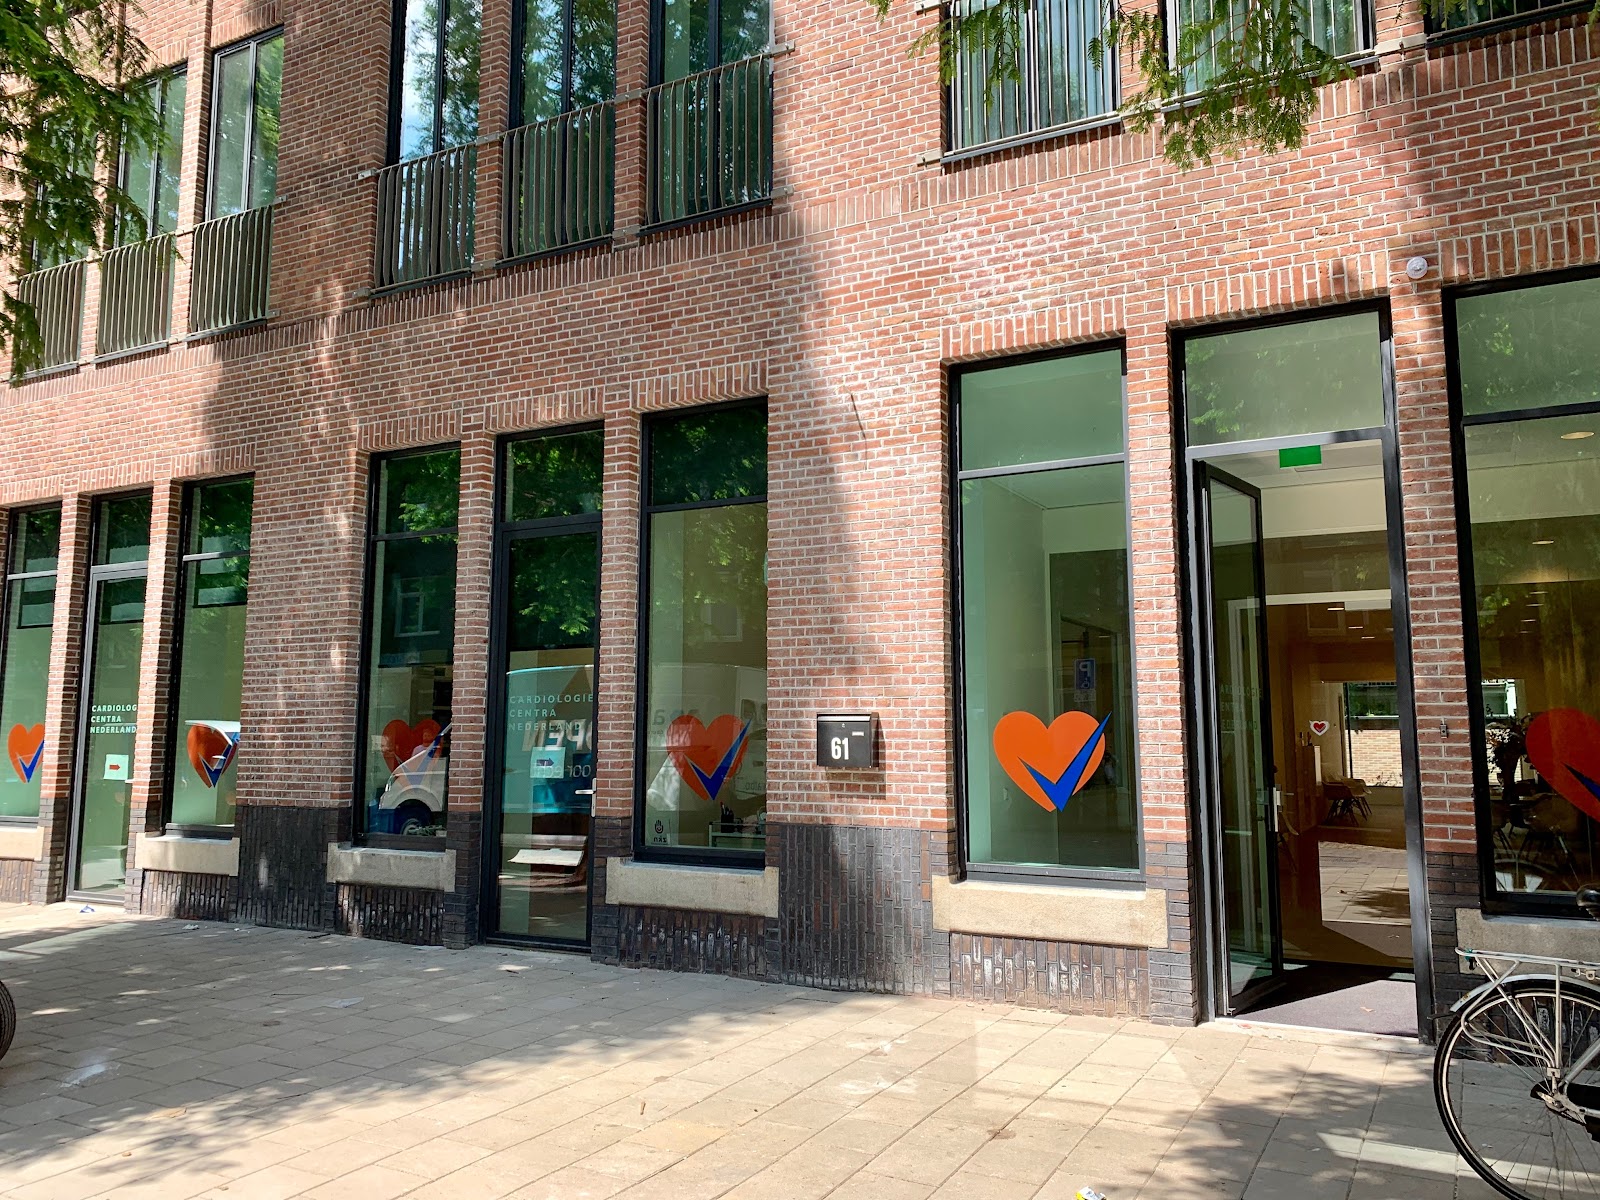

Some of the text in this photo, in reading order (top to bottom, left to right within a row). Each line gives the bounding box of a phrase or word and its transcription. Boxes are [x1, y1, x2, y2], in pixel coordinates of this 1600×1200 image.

[509, 694, 593, 704] CARDIOLOGIE
[91, 704, 138, 712] CARDIOLOG
[509, 708, 557, 718] CENTRA
[90, 715, 122, 723] CENTRA
[89, 726, 137, 734] NEDERLAND
[507, 721, 581, 731] NEDERLAND
[831, 737, 849, 760] 61
